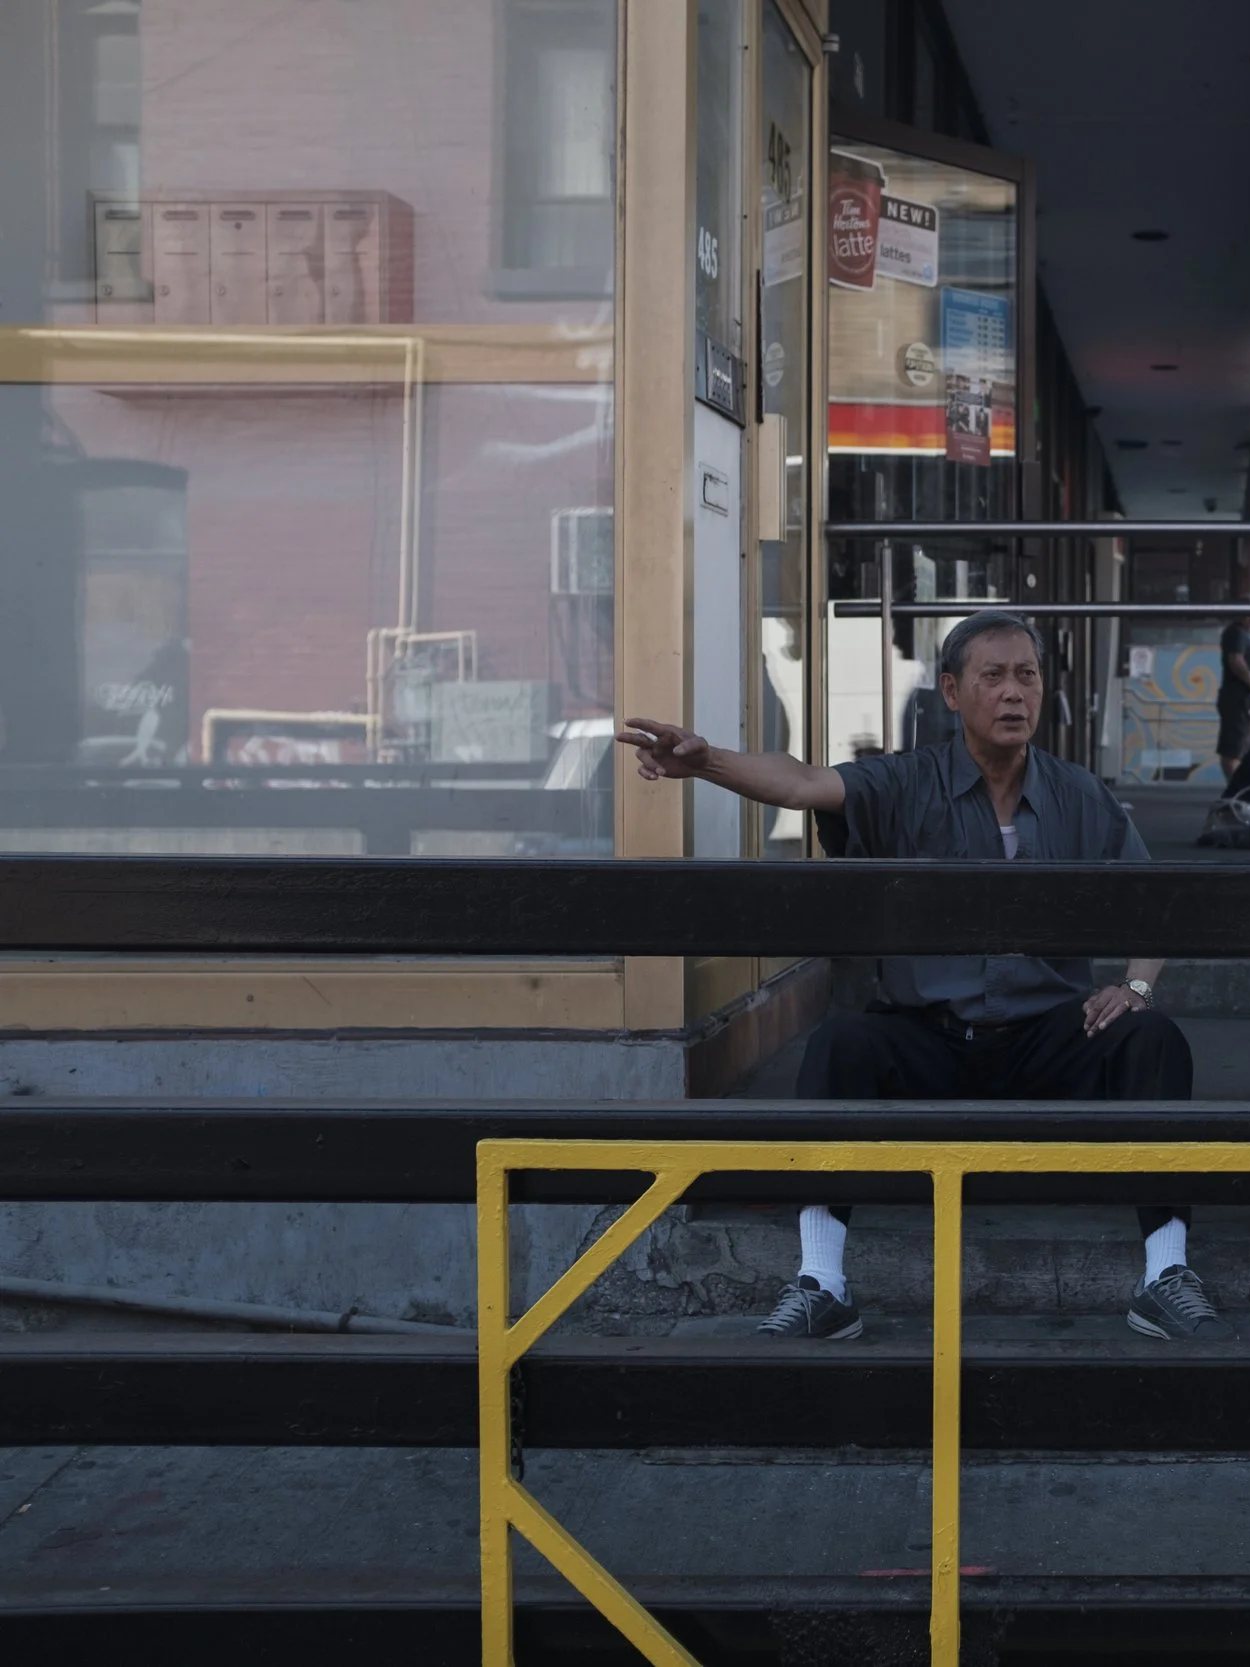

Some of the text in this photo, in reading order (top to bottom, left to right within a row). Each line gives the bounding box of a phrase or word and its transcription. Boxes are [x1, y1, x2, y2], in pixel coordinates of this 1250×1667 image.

[887, 201, 931, 226] NEW!
[698, 226, 718, 279] 485
[833, 231, 873, 257] latte
[880, 245, 911, 263] lattes
